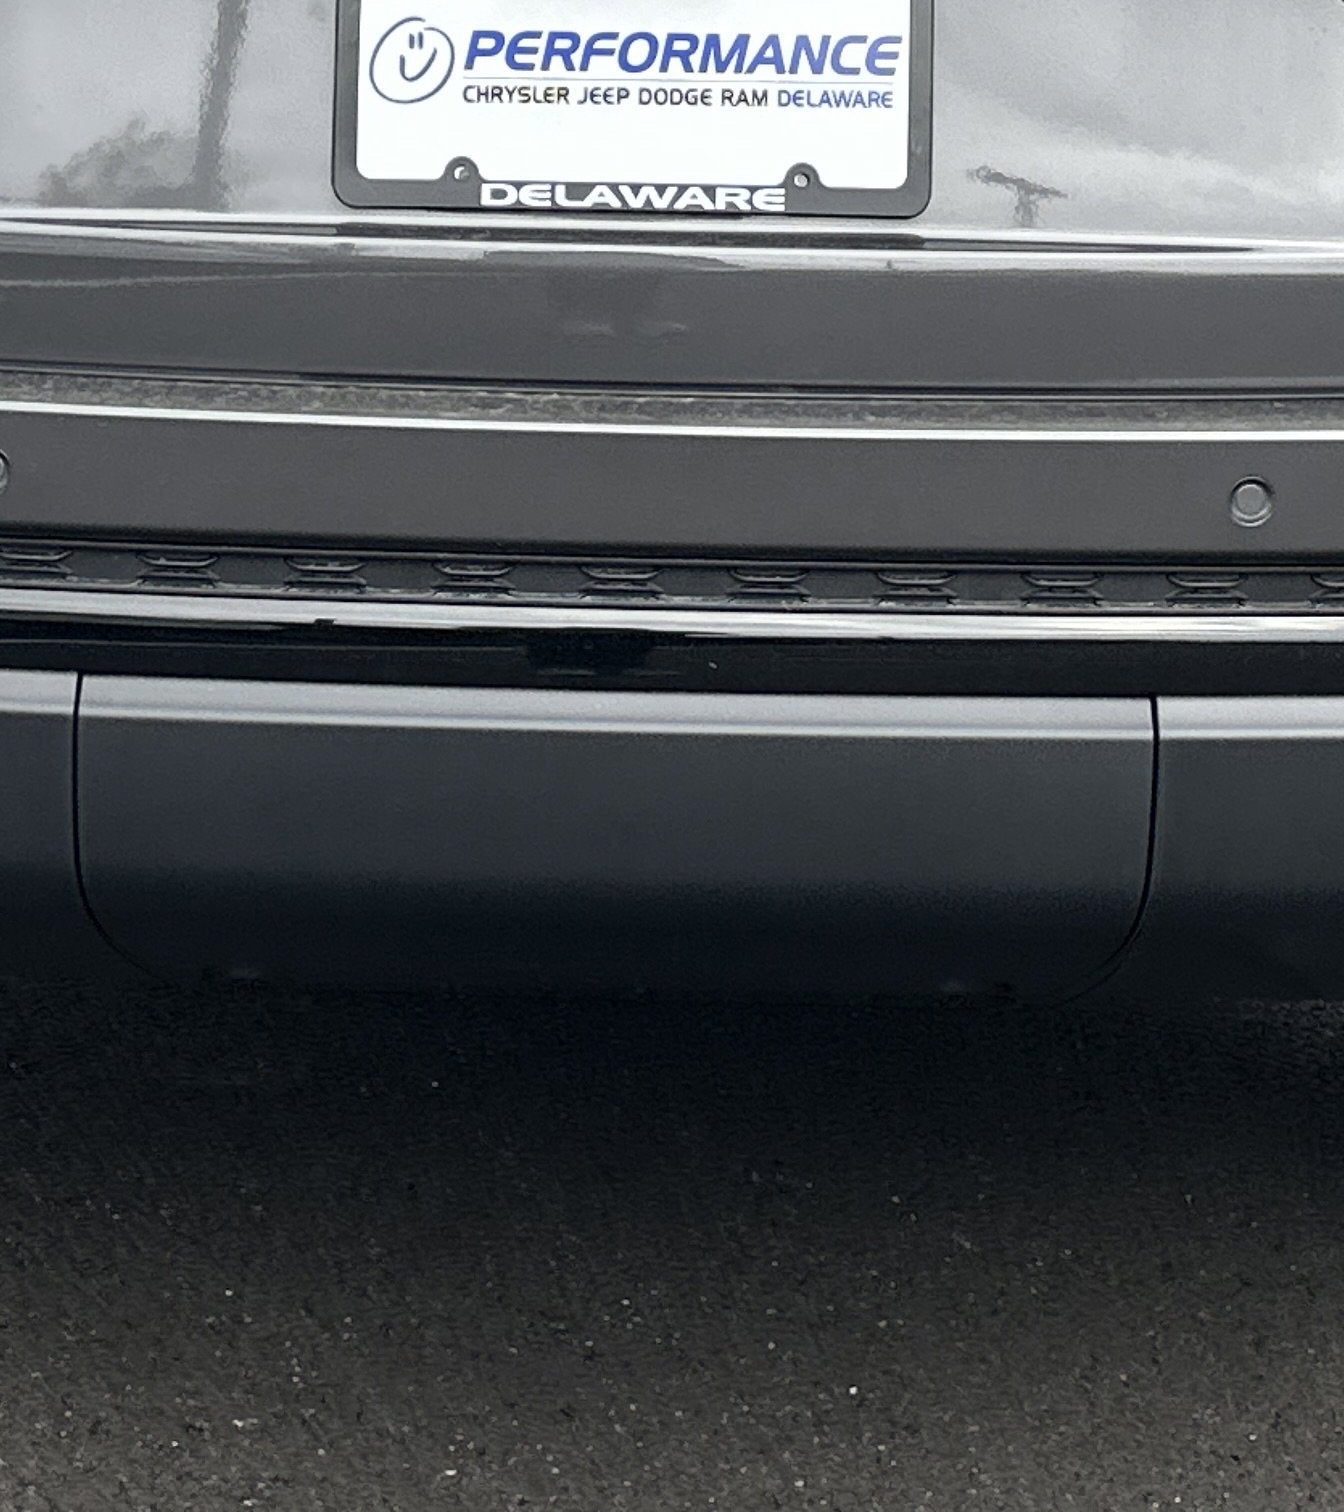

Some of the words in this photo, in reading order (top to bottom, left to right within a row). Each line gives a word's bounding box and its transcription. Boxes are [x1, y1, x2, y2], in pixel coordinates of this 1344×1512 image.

[463, 29, 903, 76] PERFORMANCE
[462, 85, 570, 105] CHRYSLER
[576, 87, 630, 106] JEEP
[638, 88, 713, 107] DODGE
[721, 89, 769, 108] RAM
[777, 89, 894, 109] DELAWARE
[481, 183, 786, 210] DELAWARE
